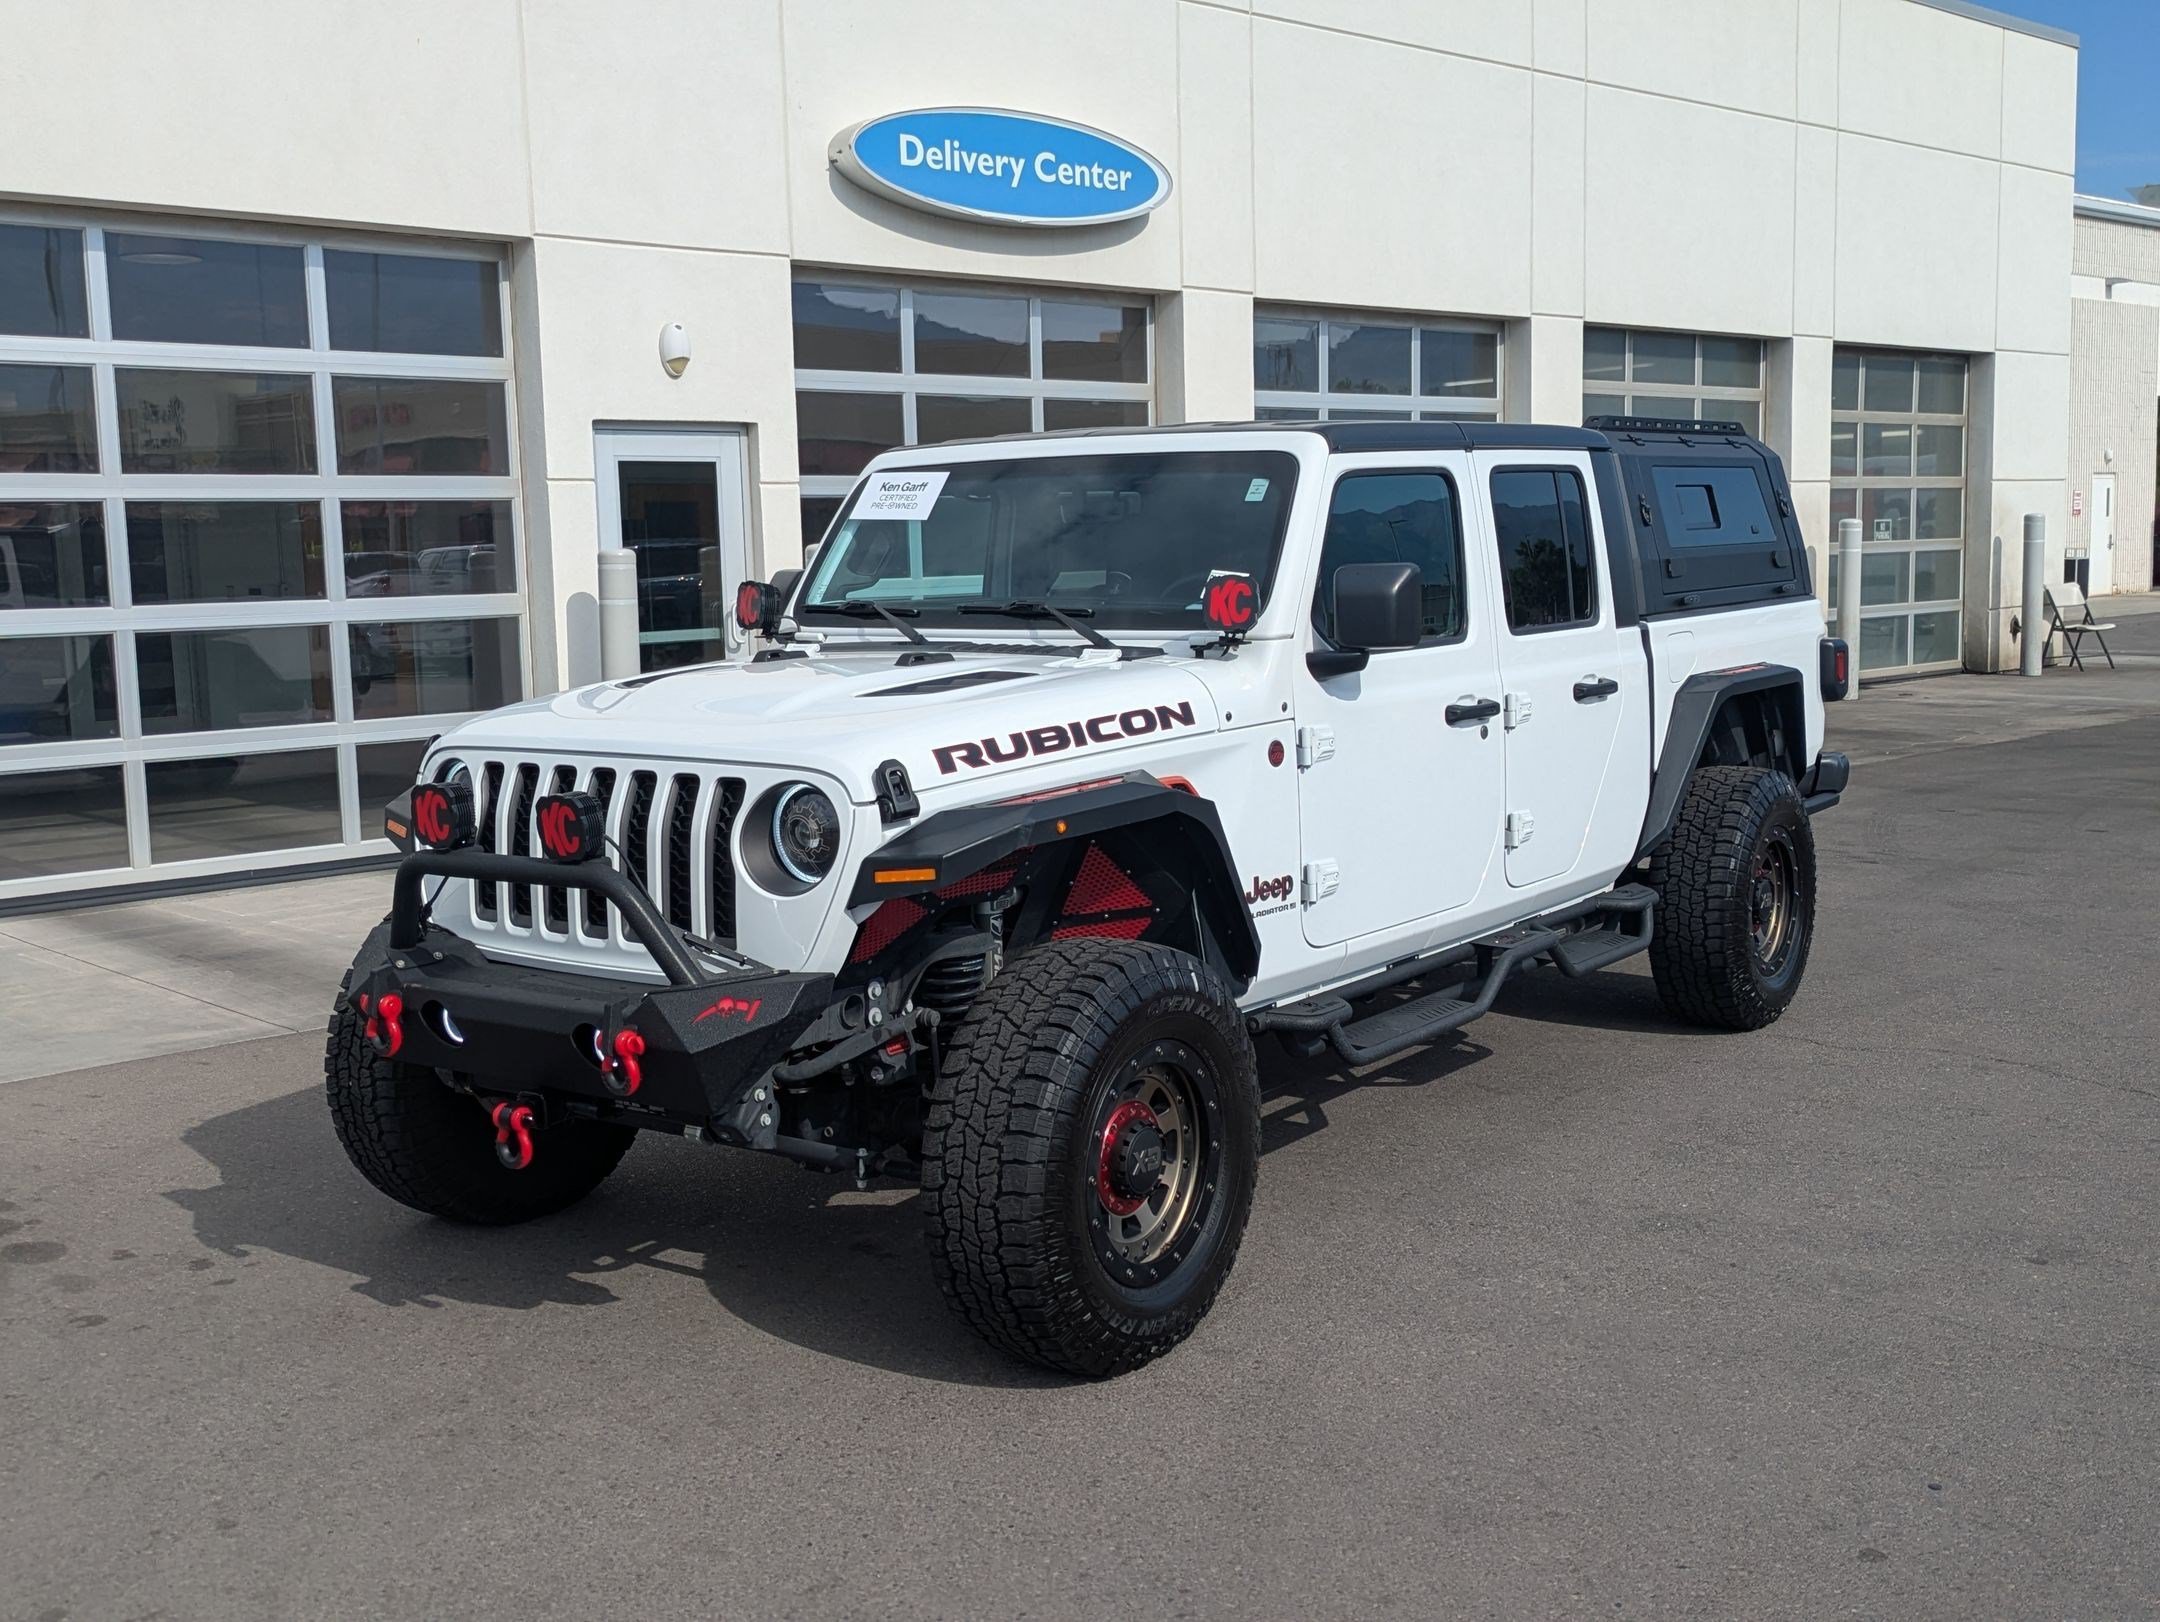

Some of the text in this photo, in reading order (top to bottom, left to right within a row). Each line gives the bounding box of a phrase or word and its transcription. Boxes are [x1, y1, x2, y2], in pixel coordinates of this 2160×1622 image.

[900, 133, 1132, 192] Delivery Center
[870, 502, 918, 510] PRE-OWNED
[879, 481, 928, 492] Ken Garff
[879, 494, 918, 502] CERTIFIED
[739, 585, 759, 626] KC
[1208, 578, 1253, 628] KC
[931, 700, 1196, 775] RUBICON
[415, 790, 450, 844] KC
[540, 802, 580, 857] KC
[1245, 875, 1294, 905] Jeep
[1250, 904, 1289, 919] LADIATOR
